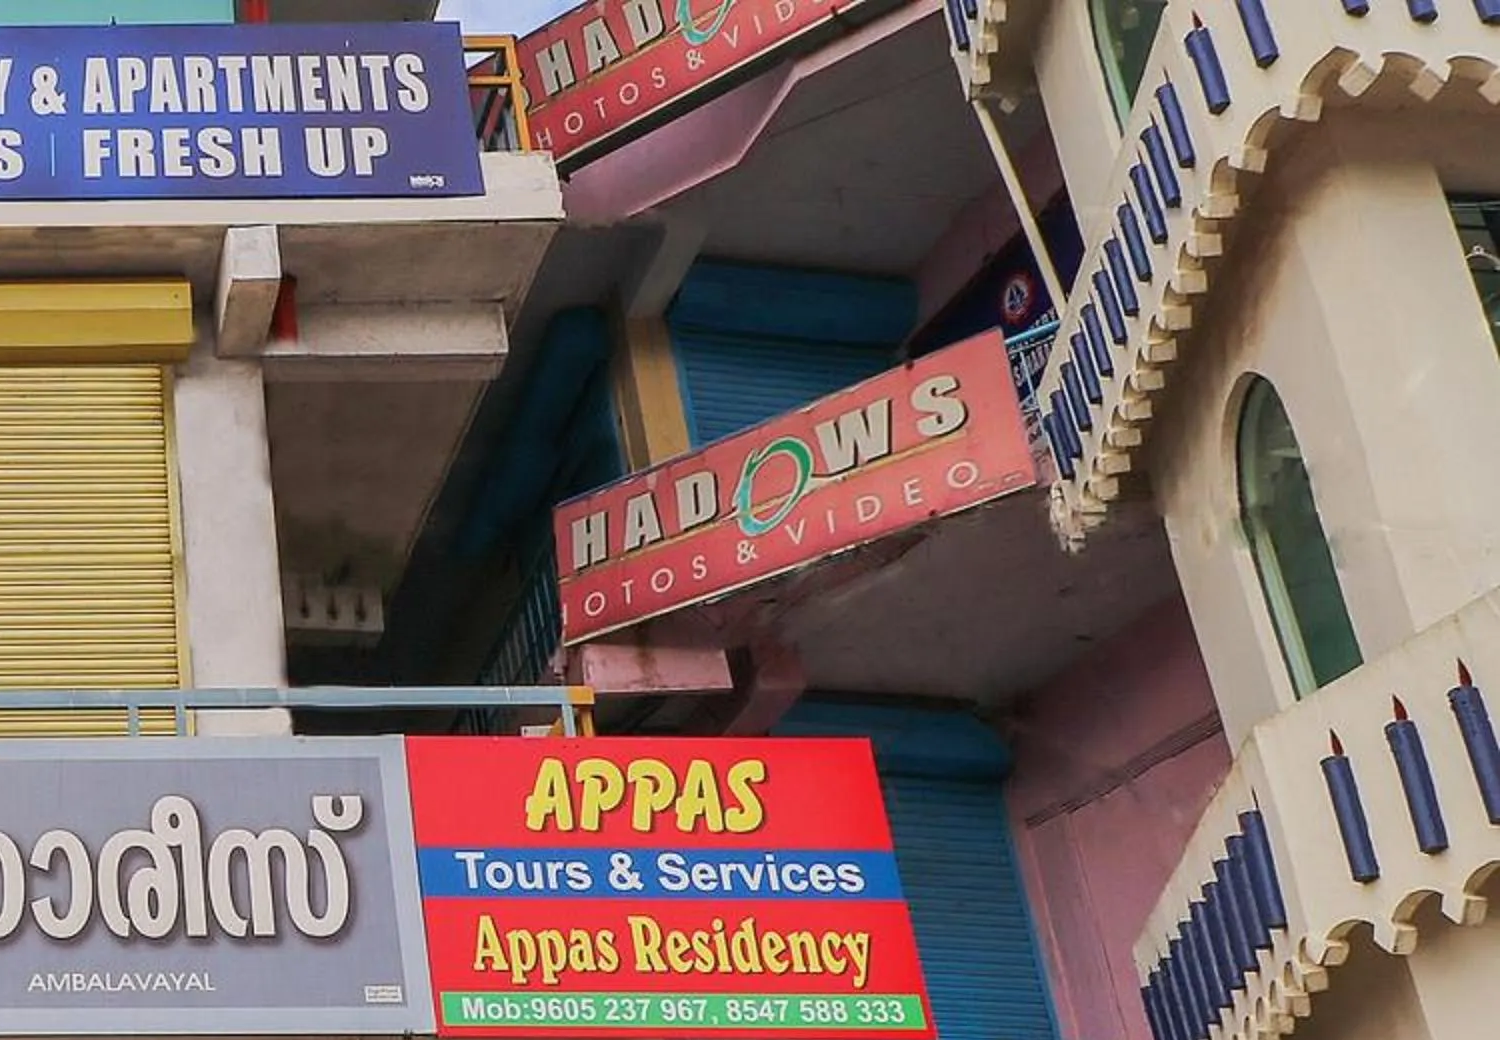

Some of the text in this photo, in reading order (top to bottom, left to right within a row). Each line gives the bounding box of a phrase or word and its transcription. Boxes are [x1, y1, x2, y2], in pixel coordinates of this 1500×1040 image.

[687, 49, 706, 71] &
[723, 0, 832, 49] VID
[31, 66, 67, 115] &
[83, 53, 429, 115] APARTMENTS
[83, 126, 284, 178] FRESH
[305, 126, 388, 176] UP
[736, 540, 759, 564] &
[784, 461, 979, 545] VIDEO
[524, 757, 768, 834] APPAS
[456, 851, 864, 893] Tours & Services
[474, 914, 871, 989] Appas Residency
[27, 973, 215, 993] AMBALAVAYAL
[463, 999, 904, 1025] Mob:9605 237 967, 8547 588 333
